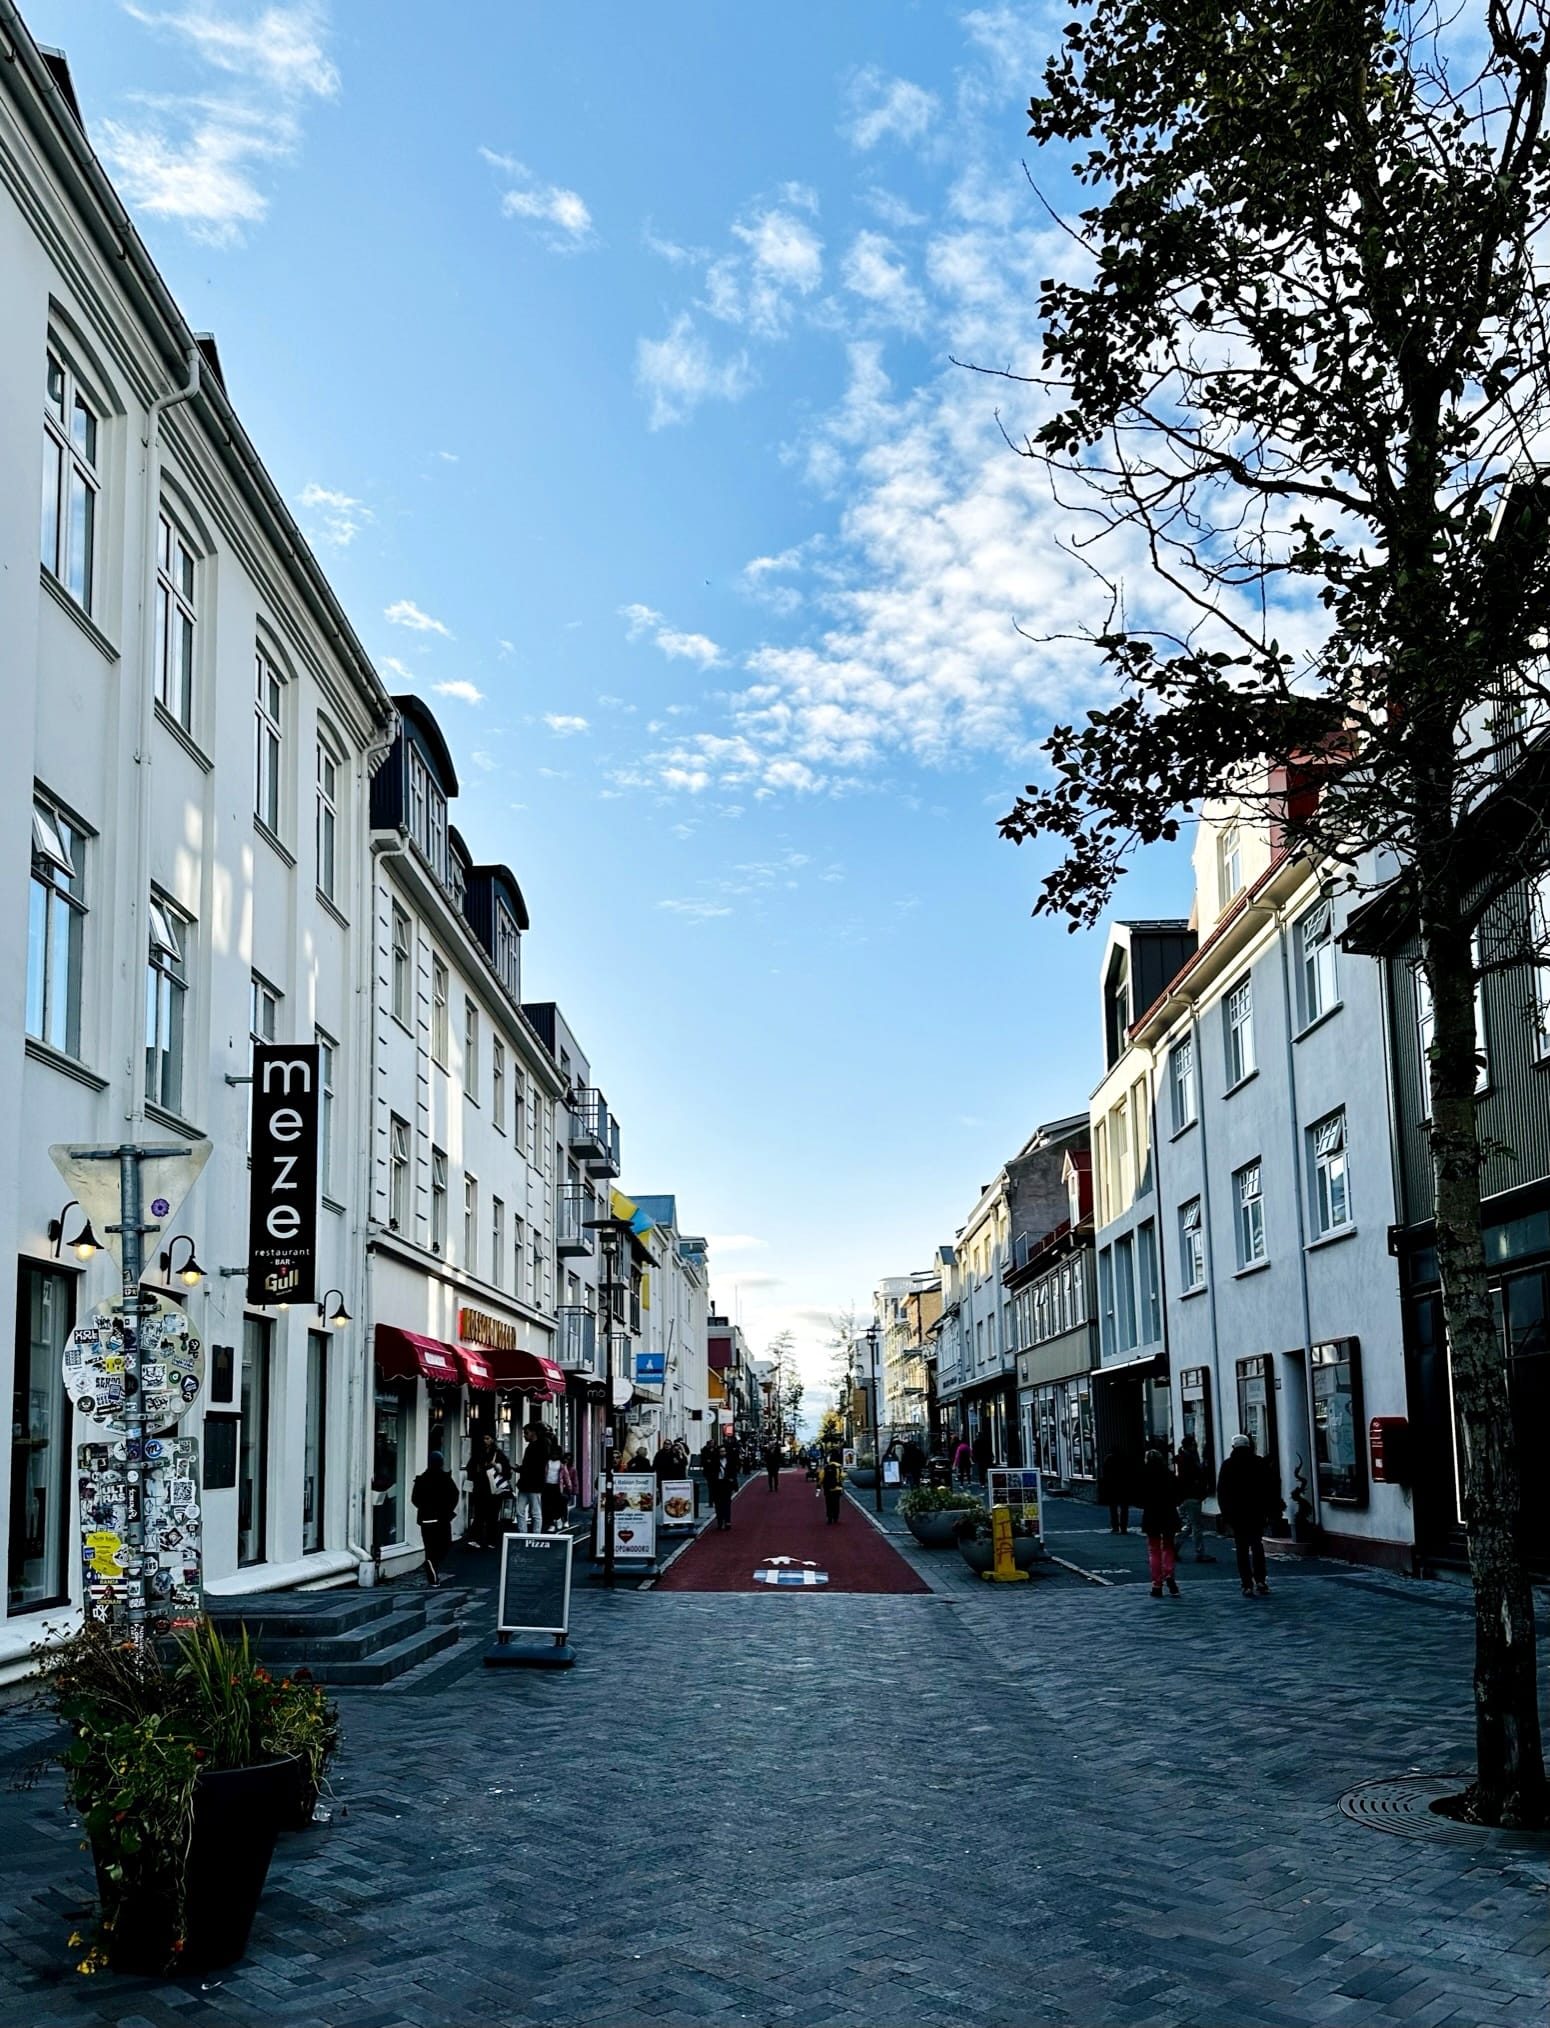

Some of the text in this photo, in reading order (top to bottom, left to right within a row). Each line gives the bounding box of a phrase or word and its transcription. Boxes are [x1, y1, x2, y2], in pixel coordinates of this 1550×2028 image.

[262, 1059, 311, 1239] meze
[254, 1248, 311, 1257] restaurant
[264, 1269, 300, 1293] Gull
[525, 1539, 551, 1548] Pizza
